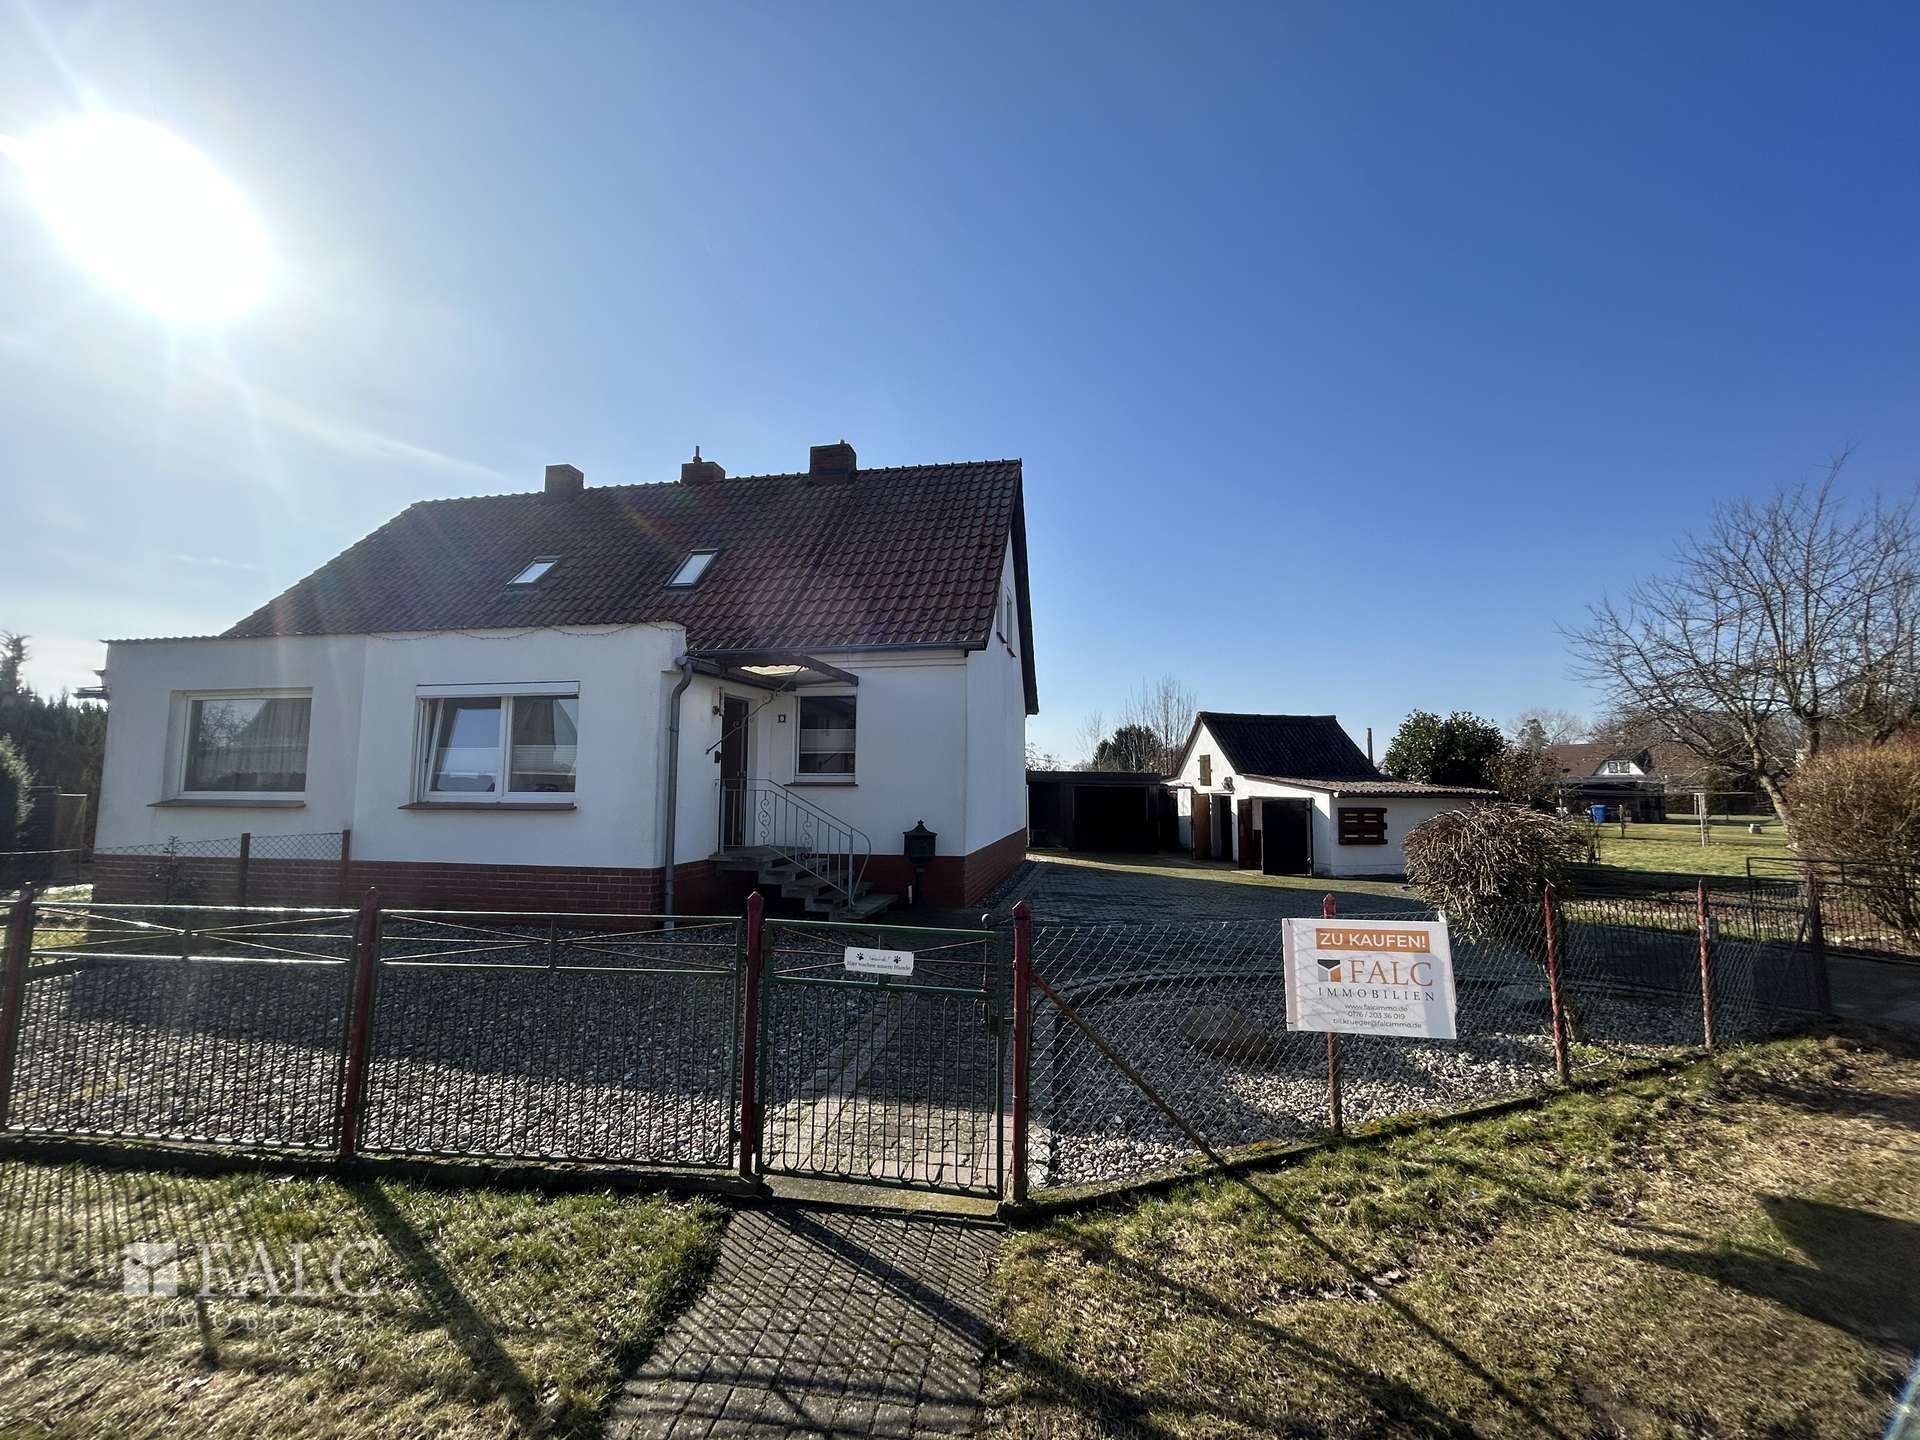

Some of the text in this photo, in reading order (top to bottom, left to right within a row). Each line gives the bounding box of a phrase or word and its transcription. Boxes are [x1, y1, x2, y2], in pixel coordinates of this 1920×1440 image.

[1319, 932, 1427, 948] ZU KAUFEN!
[1348, 959, 1433, 986] FALC
[1317, 987, 1435, 1001] IMMOBILIEN
